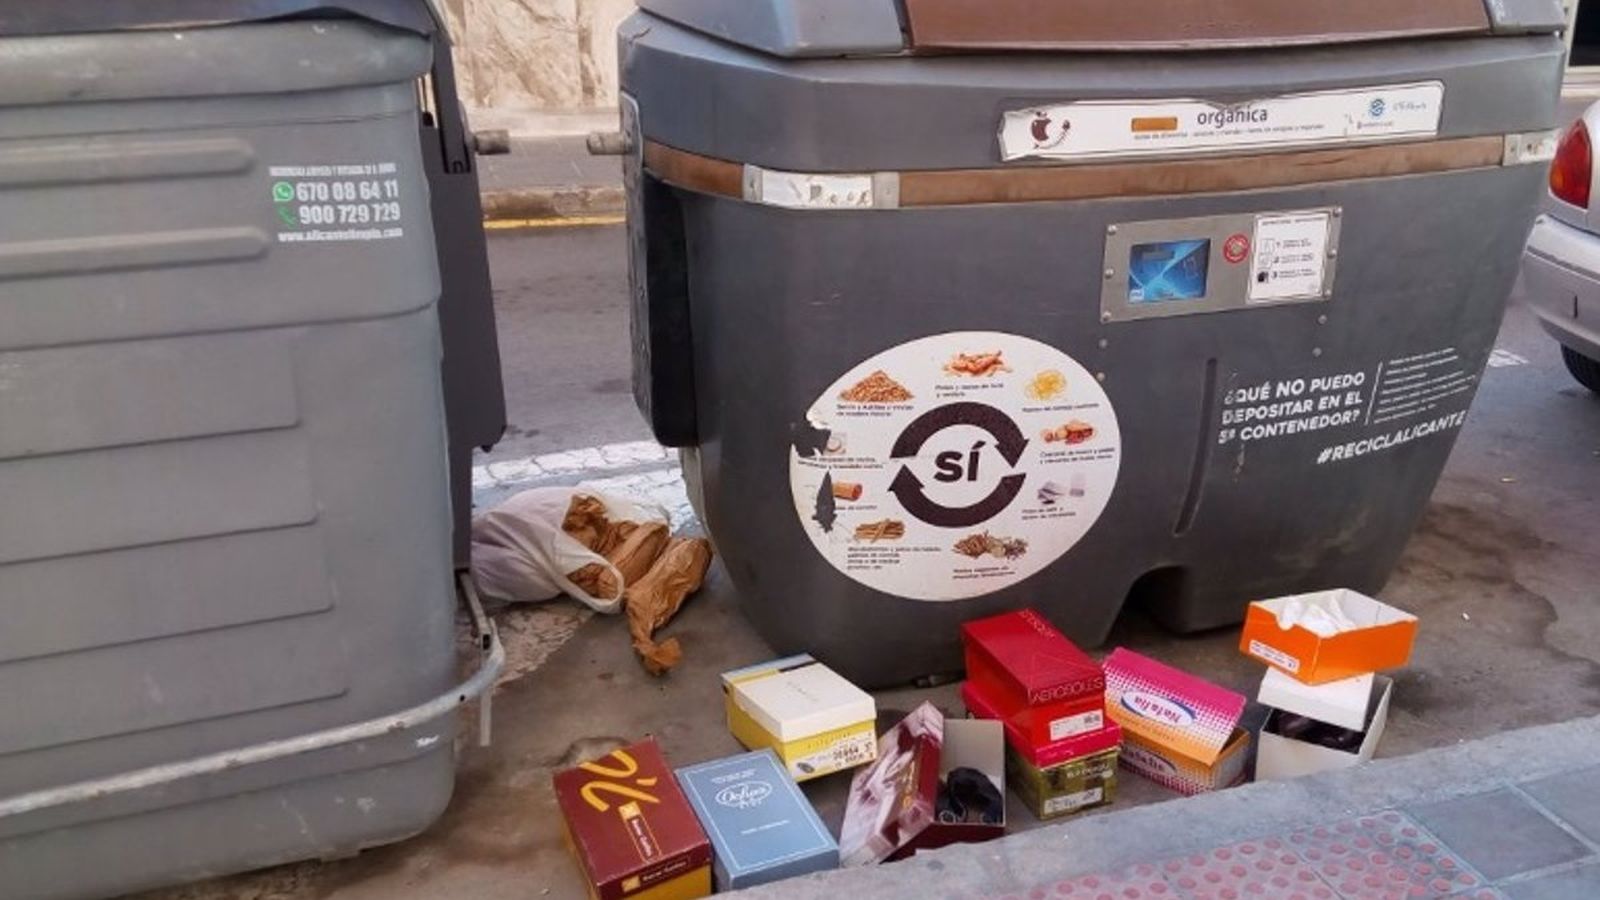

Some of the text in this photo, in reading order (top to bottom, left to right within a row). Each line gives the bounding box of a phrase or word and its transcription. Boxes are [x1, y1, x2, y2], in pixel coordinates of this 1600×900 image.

[296, 179, 399, 201] 670 08 64 11
[299, 202, 400, 224] 900 729 729
[1276, 378, 1305, 398] NO
[1309, 372, 1366, 392] PUEDO
[1221, 391, 1363, 425] DEPOSITAR EN EL
[1240, 410, 1361, 441] CONTENEDOR?
[1316, 410, 1467, 465] #RECICLALICANTE
[934, 441, 986, 482] SÍ
